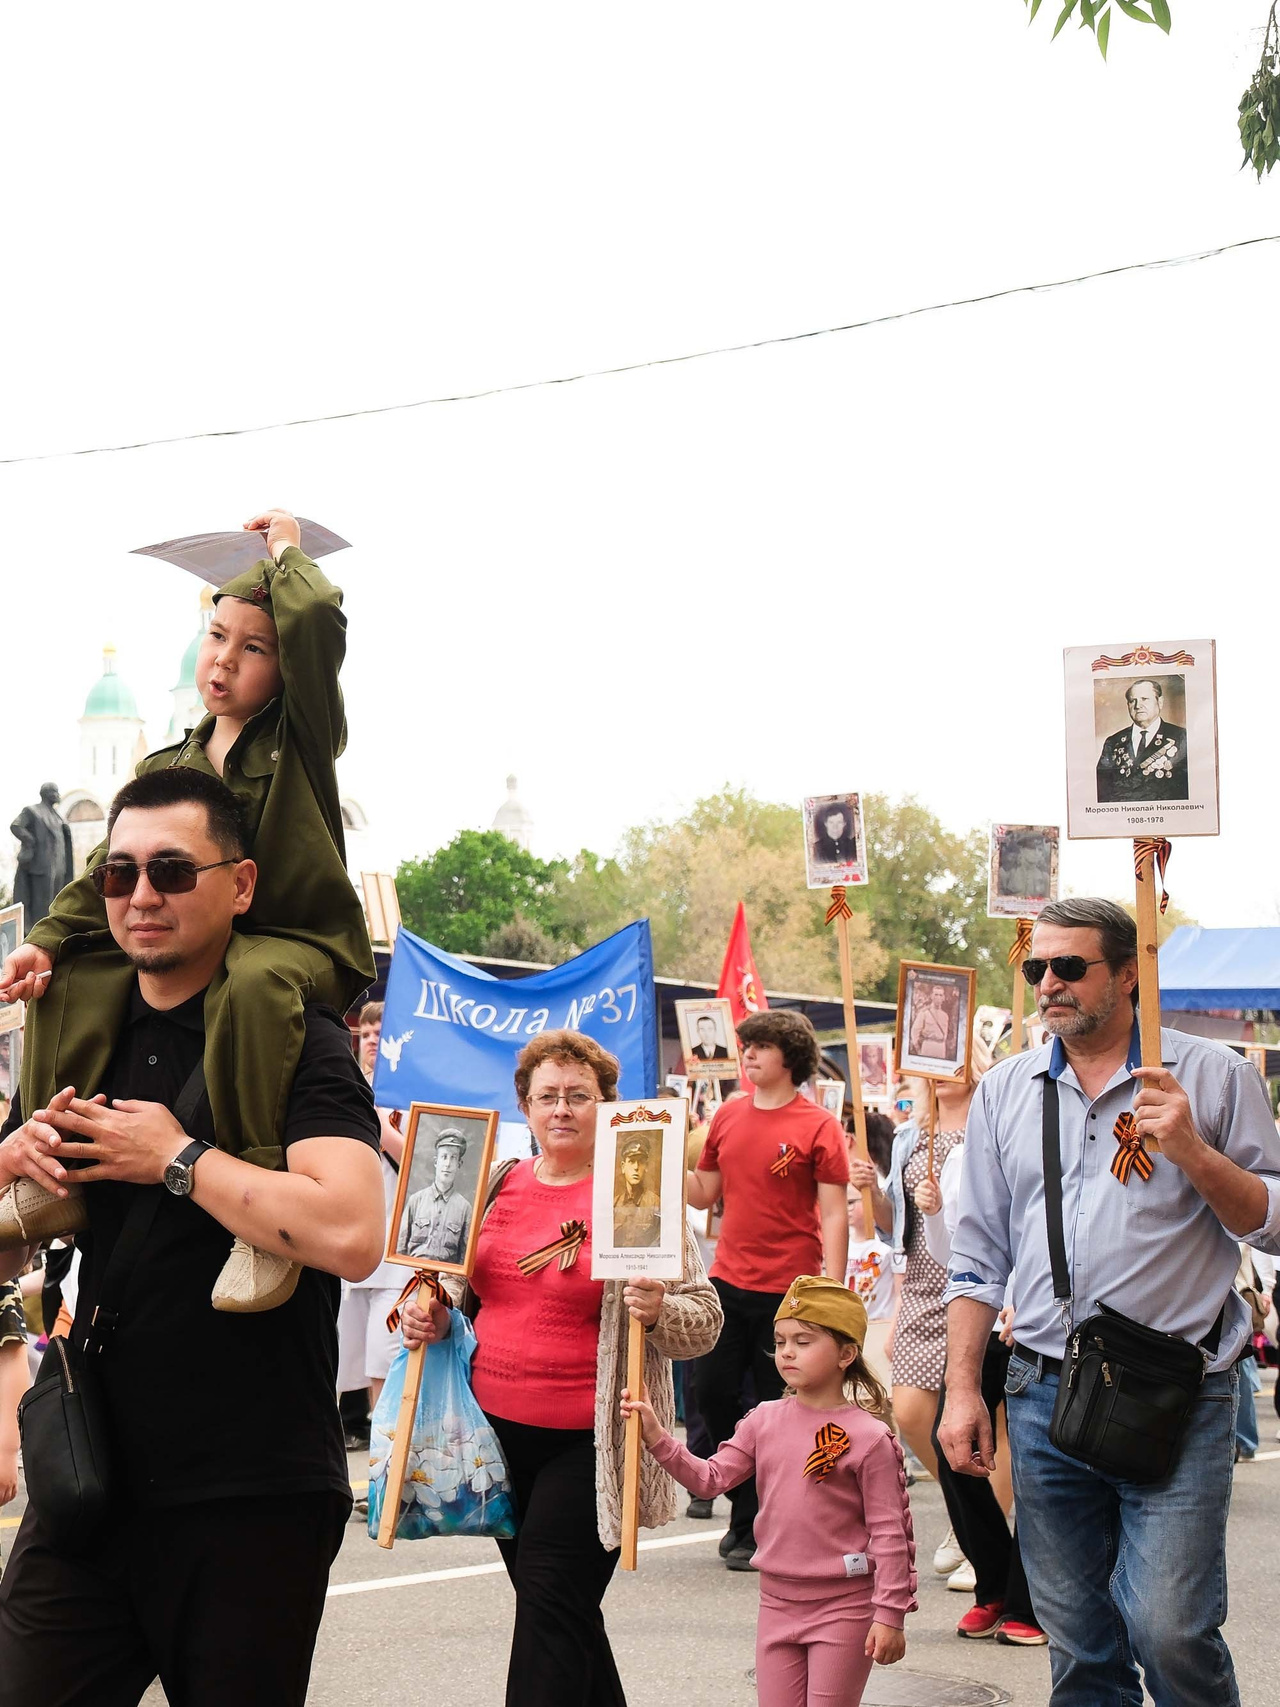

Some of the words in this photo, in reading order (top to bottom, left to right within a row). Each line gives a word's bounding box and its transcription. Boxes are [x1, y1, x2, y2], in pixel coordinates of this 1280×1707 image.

[1085, 806, 1120, 815] Морозов
[1121, 804, 1155, 813] Николай
[1156, 803, 1205, 812] Николаевич
[1126, 816, 1165, 824] 1908-1978
[413, 978, 550, 1035] Школа
